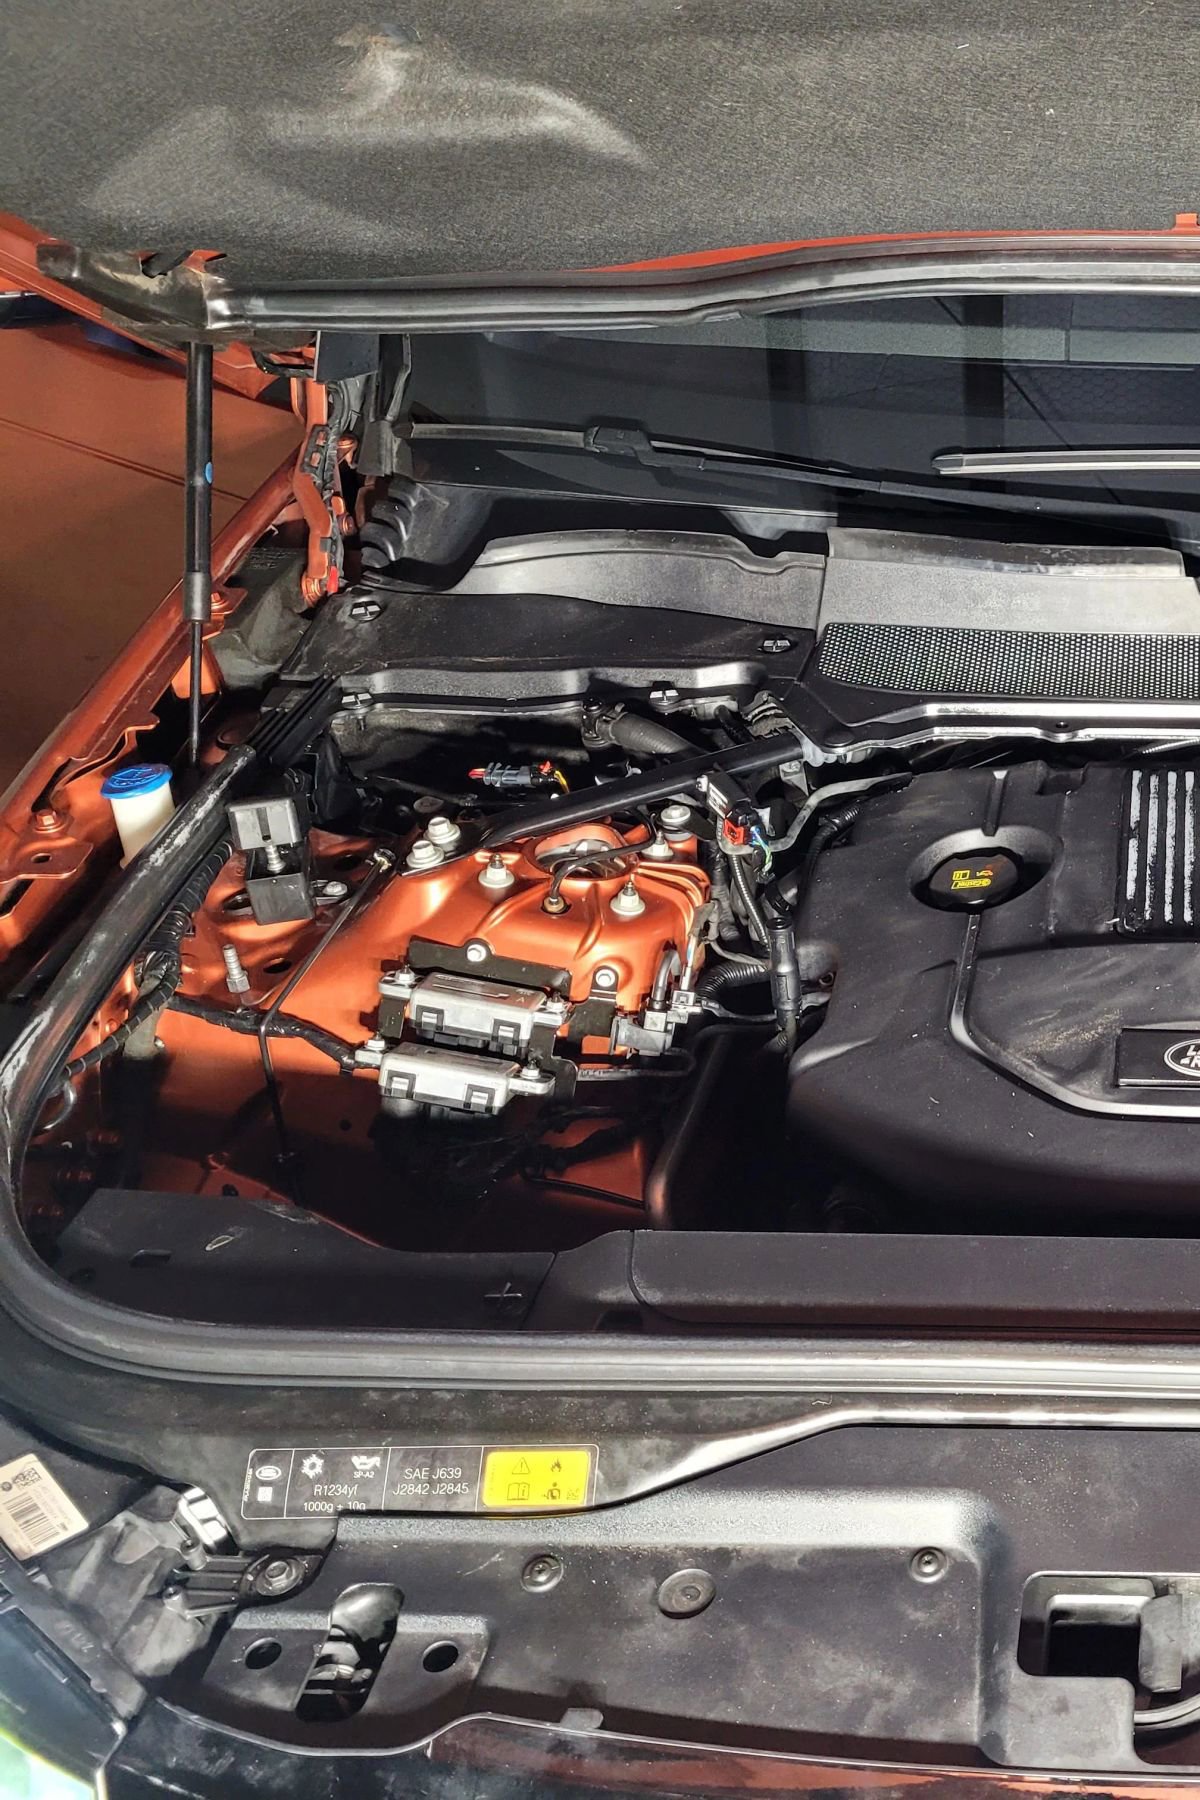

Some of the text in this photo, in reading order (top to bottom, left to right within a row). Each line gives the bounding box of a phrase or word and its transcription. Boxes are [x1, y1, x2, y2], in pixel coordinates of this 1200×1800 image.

[353, 1470, 375, 1479] SP-A2
[404, 1467, 462, 1480] SAE J639
[313, 1483, 359, 1498] R1234yf
[392, 1482, 469, 1496] J2842 J2845
[303, 1501, 334, 1513] 1000g
